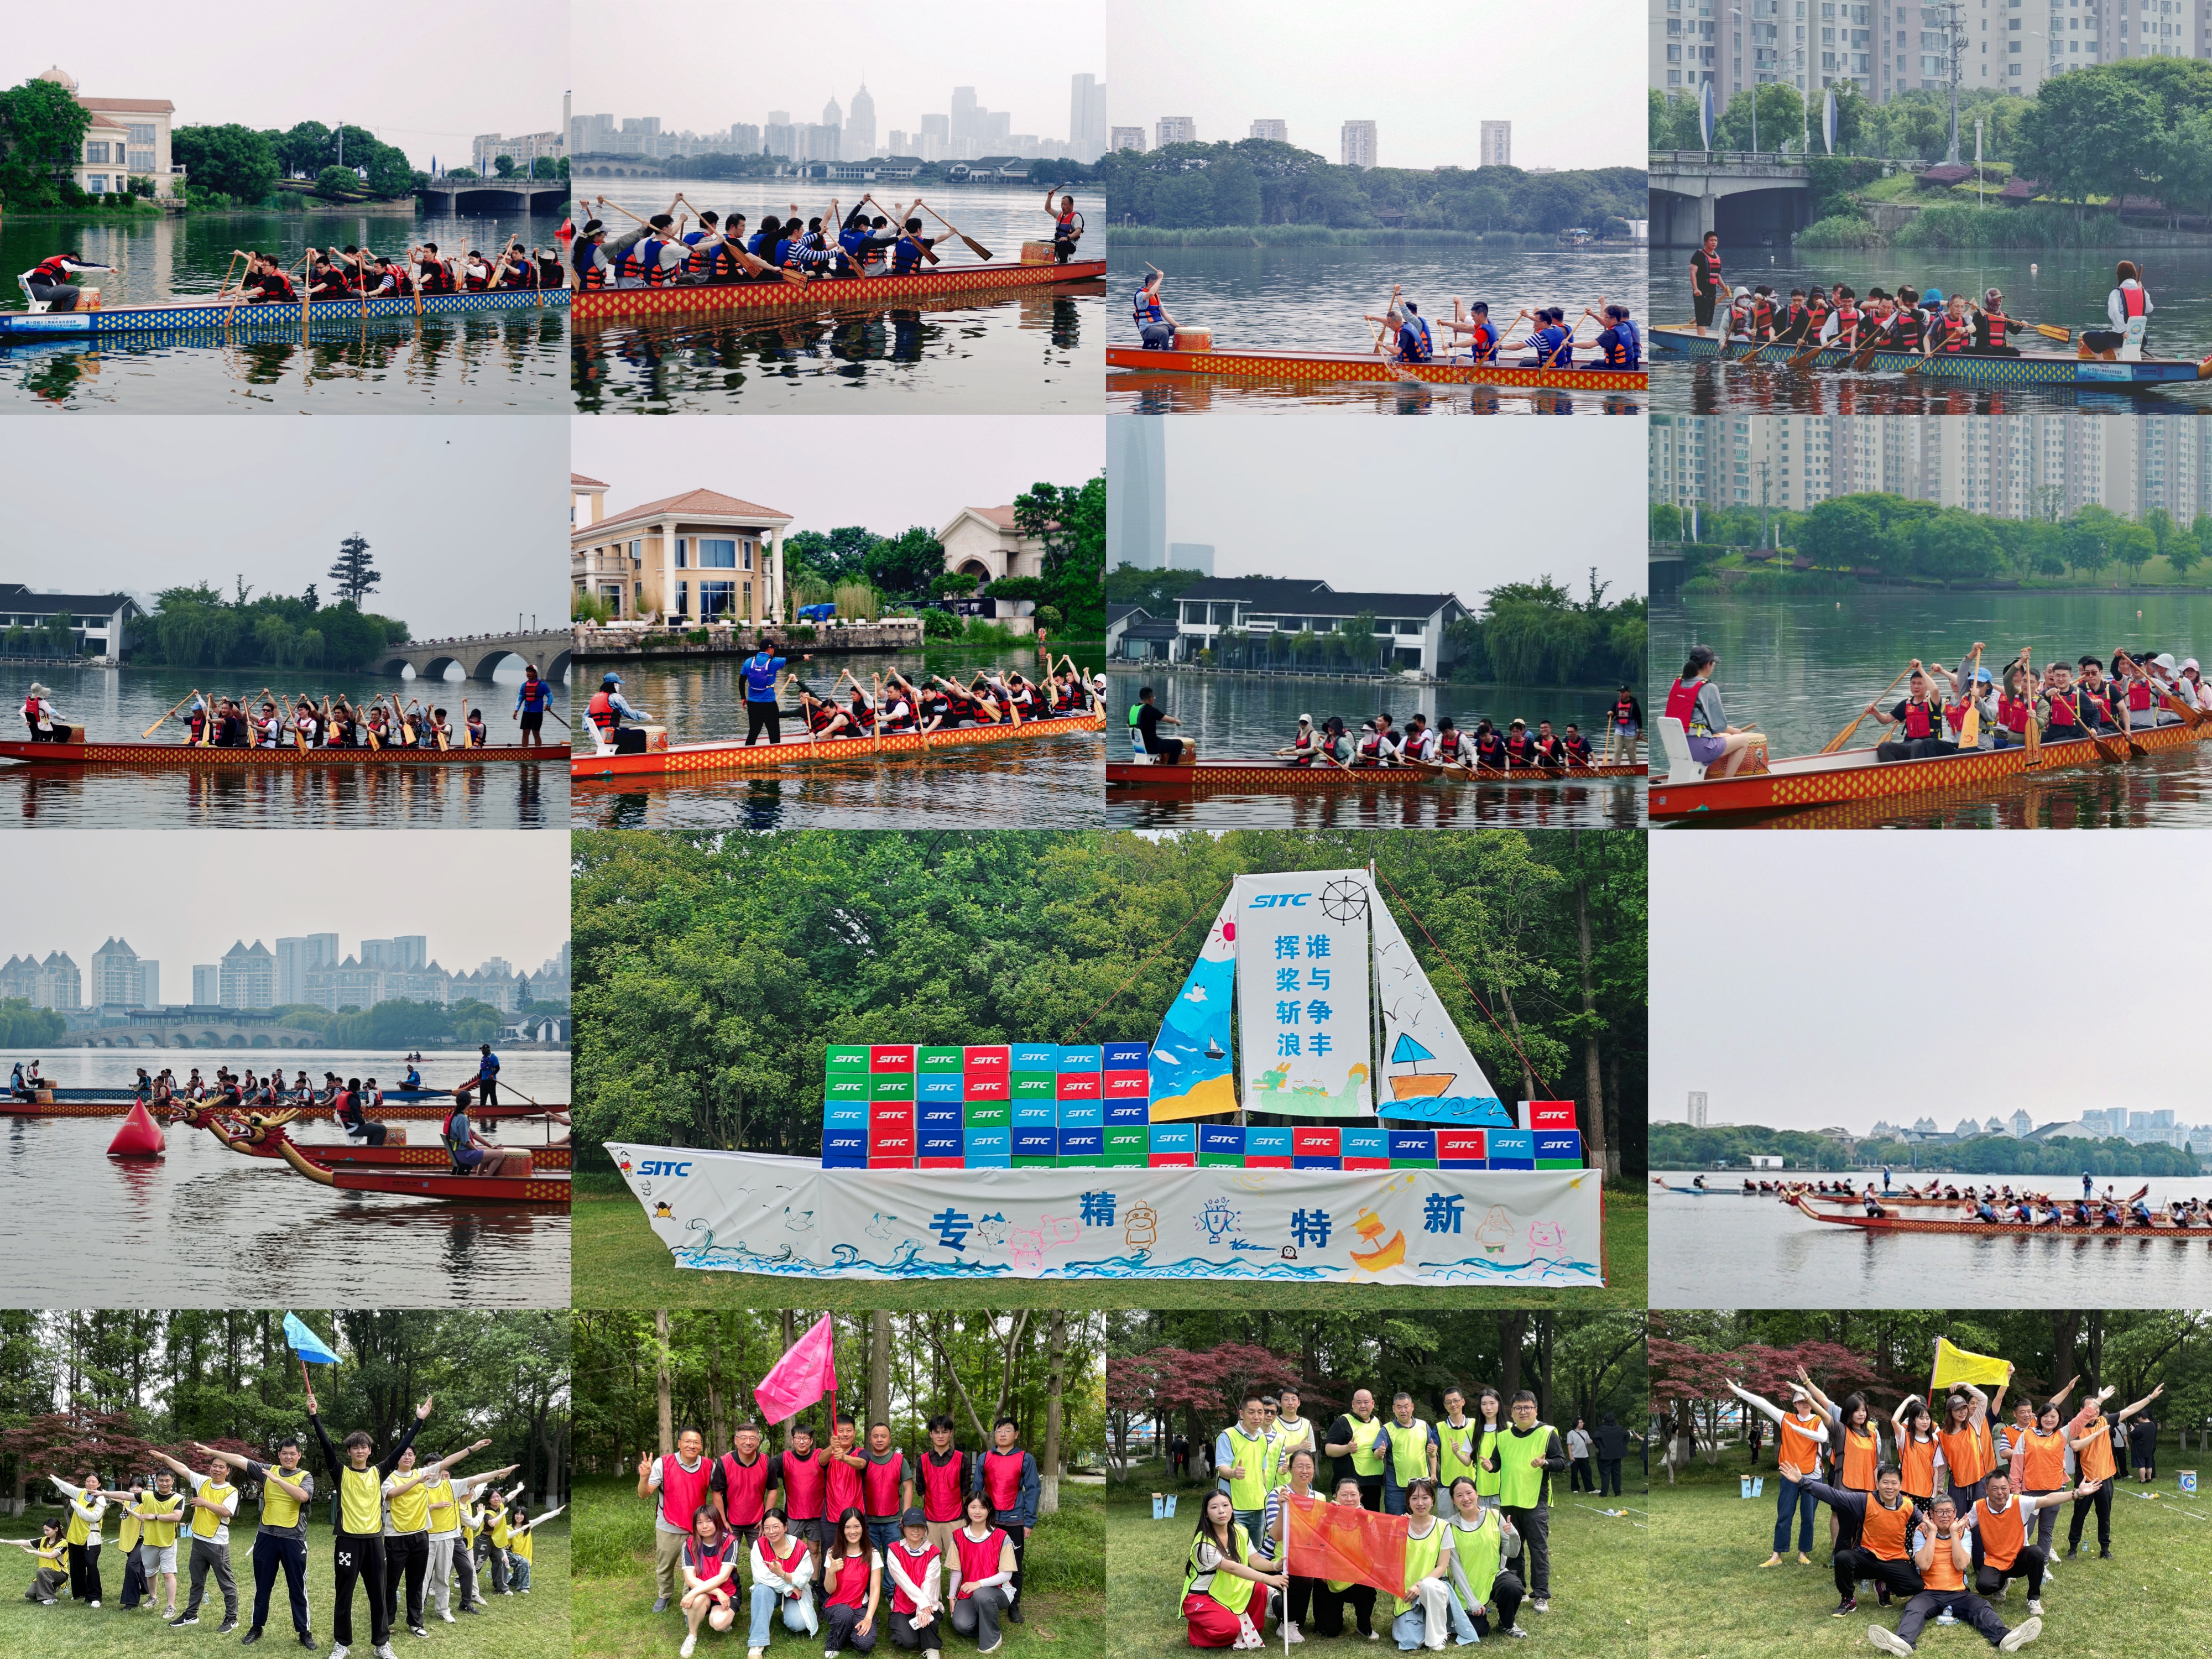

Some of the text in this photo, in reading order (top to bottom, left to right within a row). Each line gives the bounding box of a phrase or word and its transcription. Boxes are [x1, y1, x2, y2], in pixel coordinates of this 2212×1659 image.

[1248, 893, 1312, 909] SITC
[1275, 935, 1302, 1057] 挥桨斩浪
[1306, 933, 1333, 1057] 谁与争丰
[637, 1160, 693, 1177] SITC
